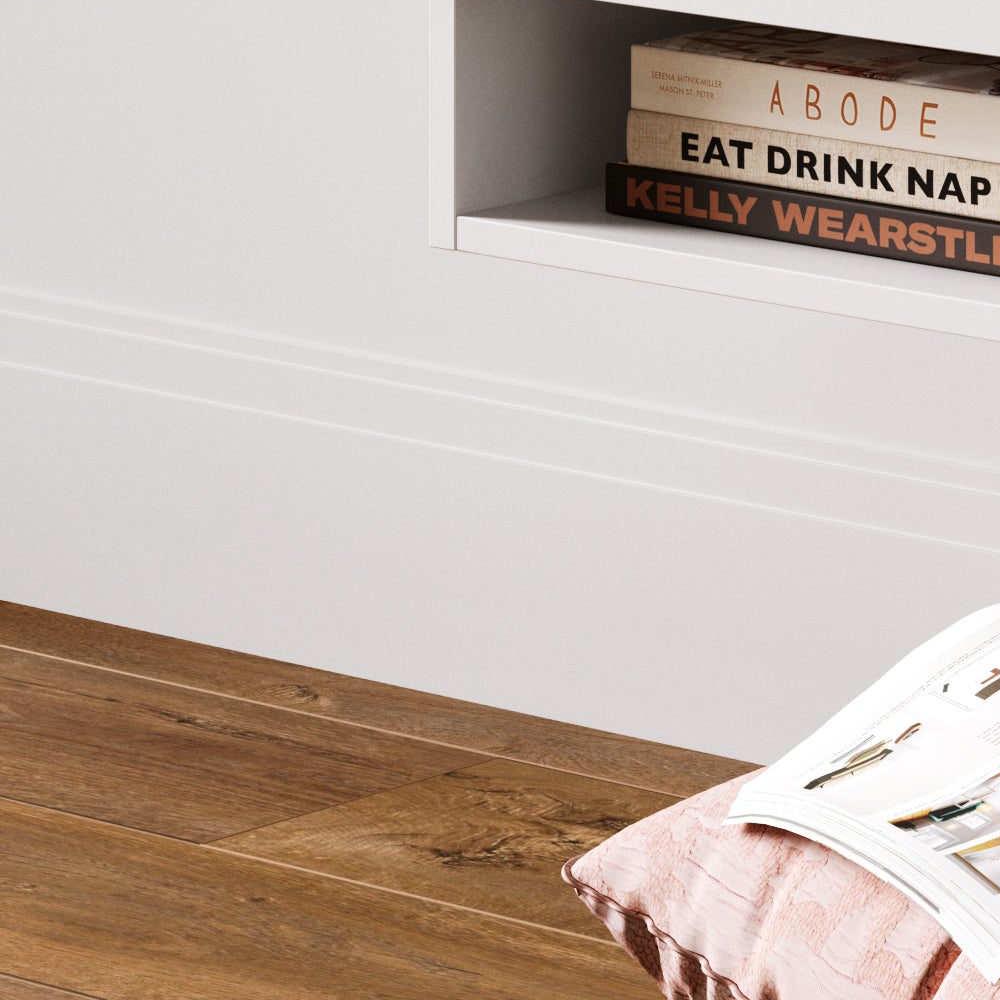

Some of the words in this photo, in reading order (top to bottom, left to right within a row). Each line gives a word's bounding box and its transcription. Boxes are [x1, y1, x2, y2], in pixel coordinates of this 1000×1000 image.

[659, 85, 684, 95] MASON
[696, 90, 714, 99] PETER
[769, 79, 939, 139] ABODE
[681, 132, 753, 169] EAT
[767, 145, 894, 192] DRINK
[907, 167, 992, 205] NAP
[626, 177, 758, 225] KELLY
